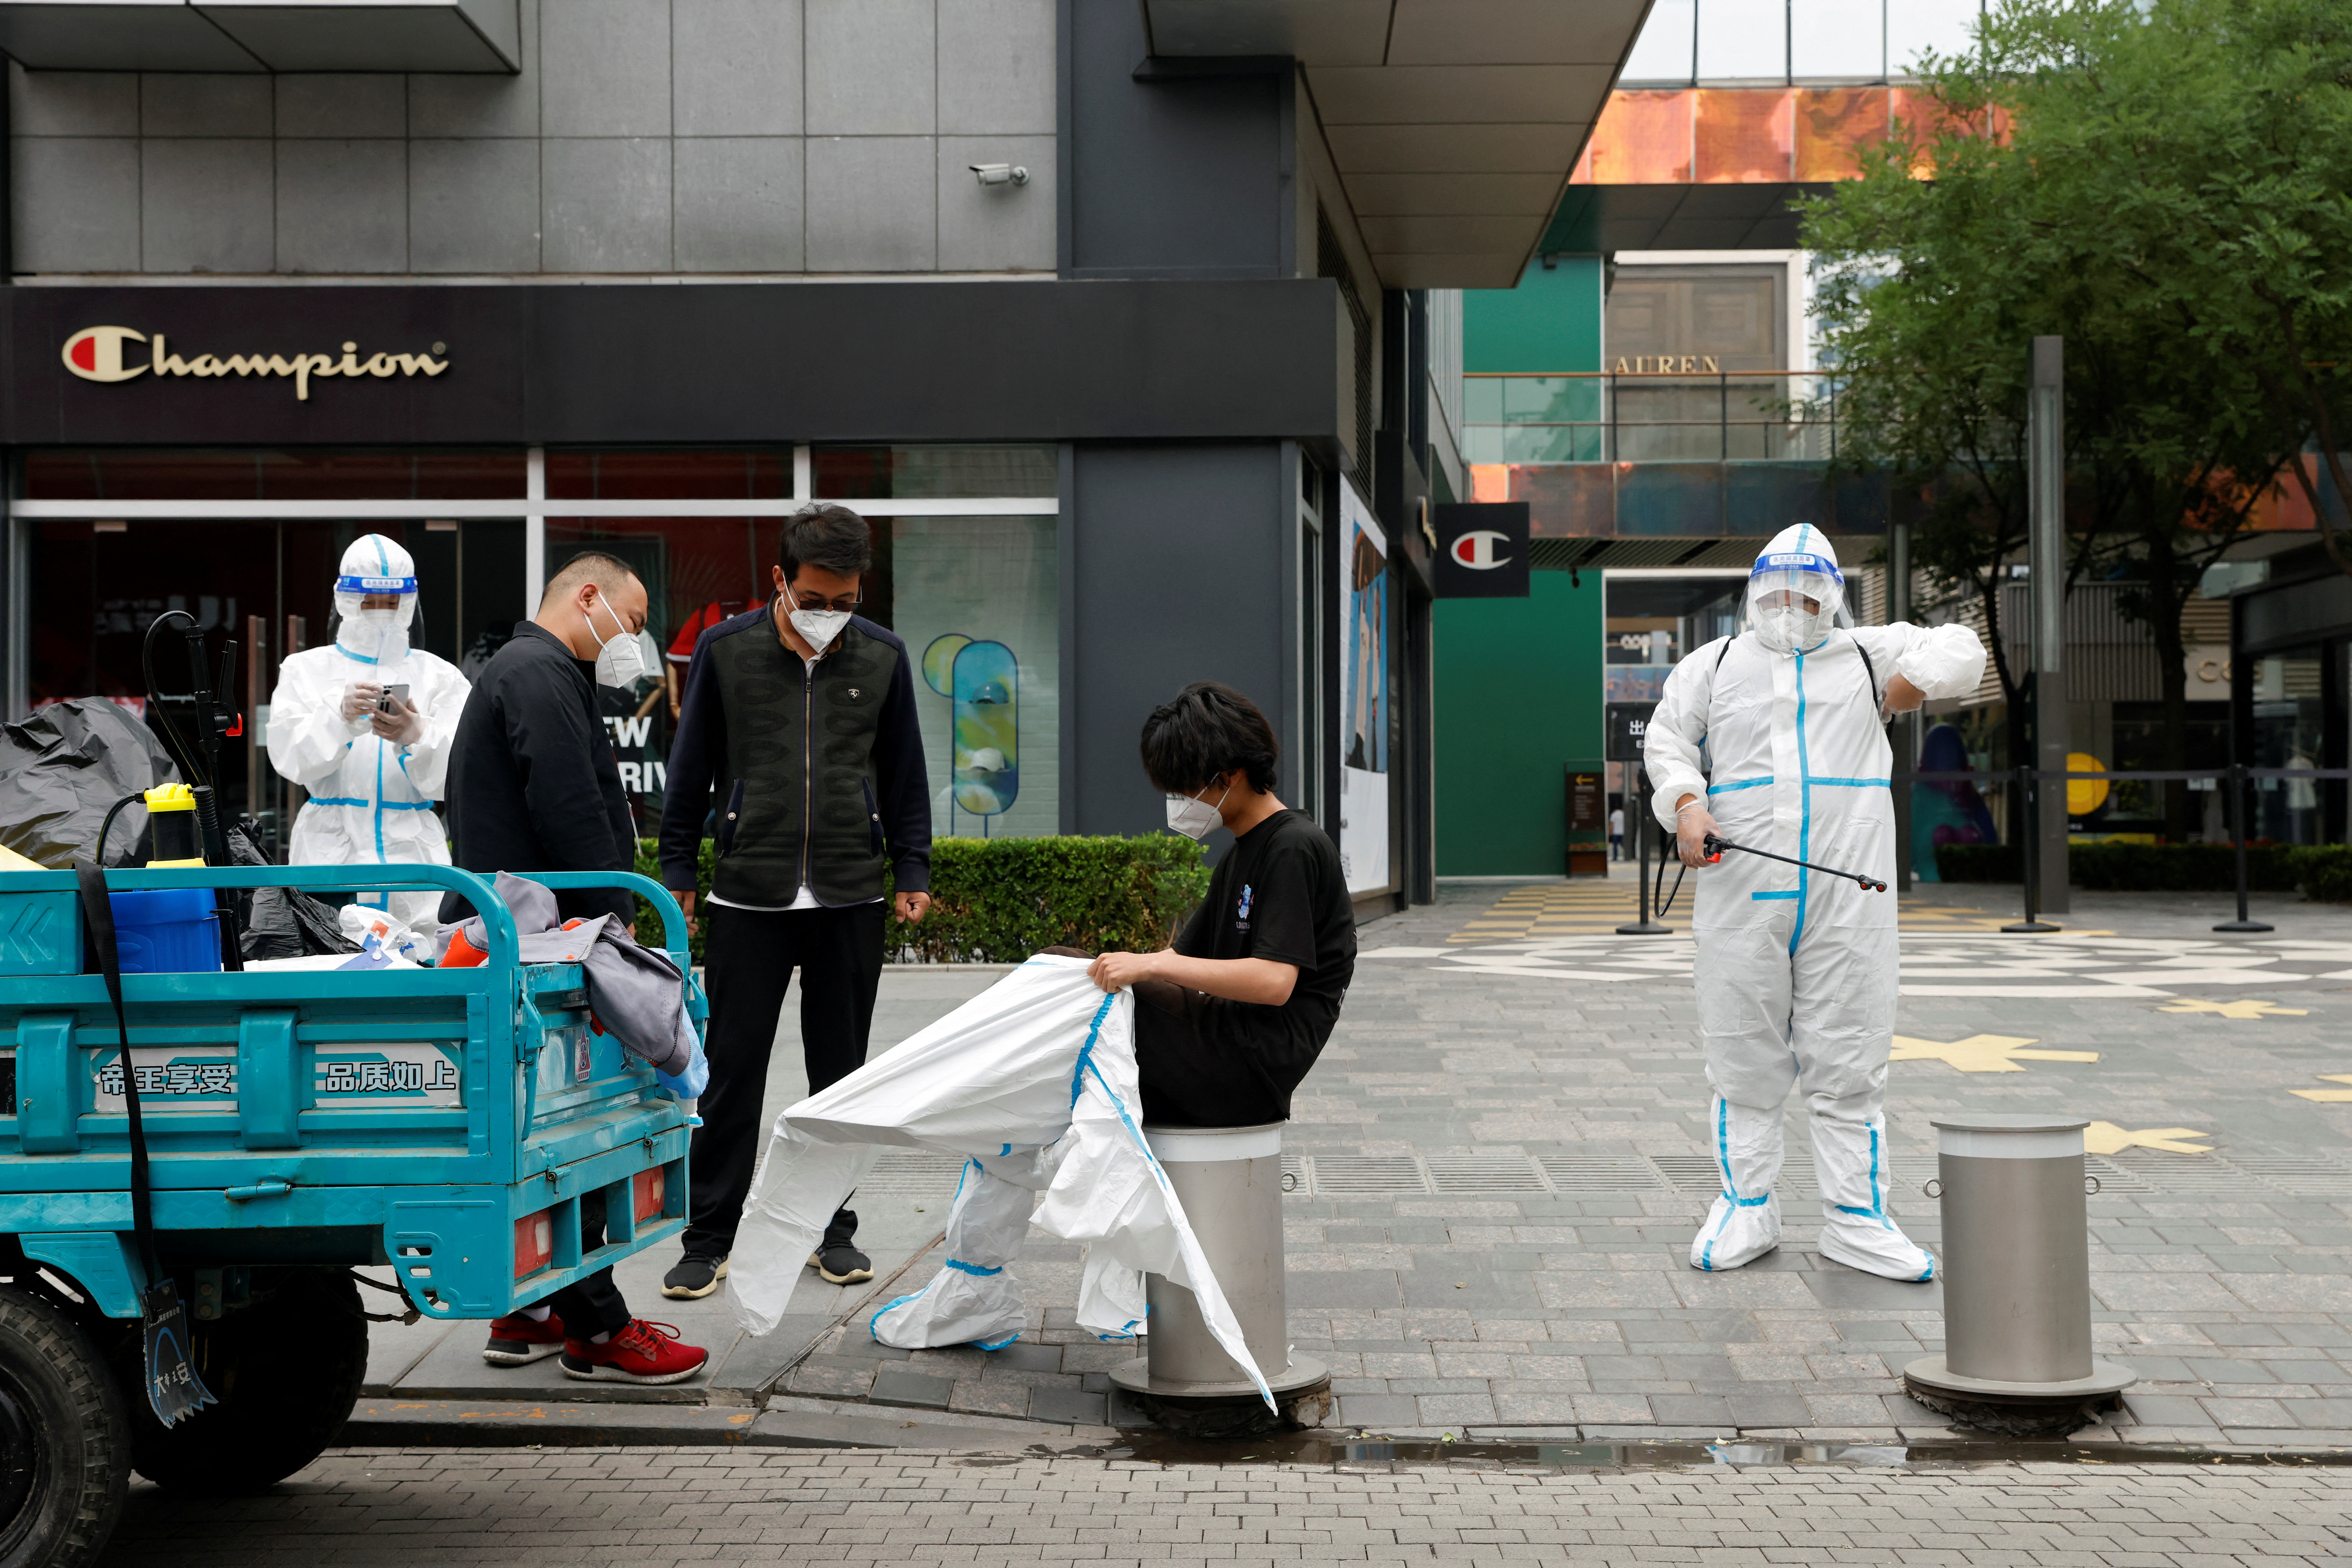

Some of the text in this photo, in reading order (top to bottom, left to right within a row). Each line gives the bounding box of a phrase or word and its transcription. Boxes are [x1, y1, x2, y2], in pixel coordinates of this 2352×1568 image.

[62, 326, 449, 400] Champion
[1605, 356, 1719, 374] AUREN
[100, 1063, 231, 1095] 帝王享受
[326, 1060, 456, 1092] 品质如上
